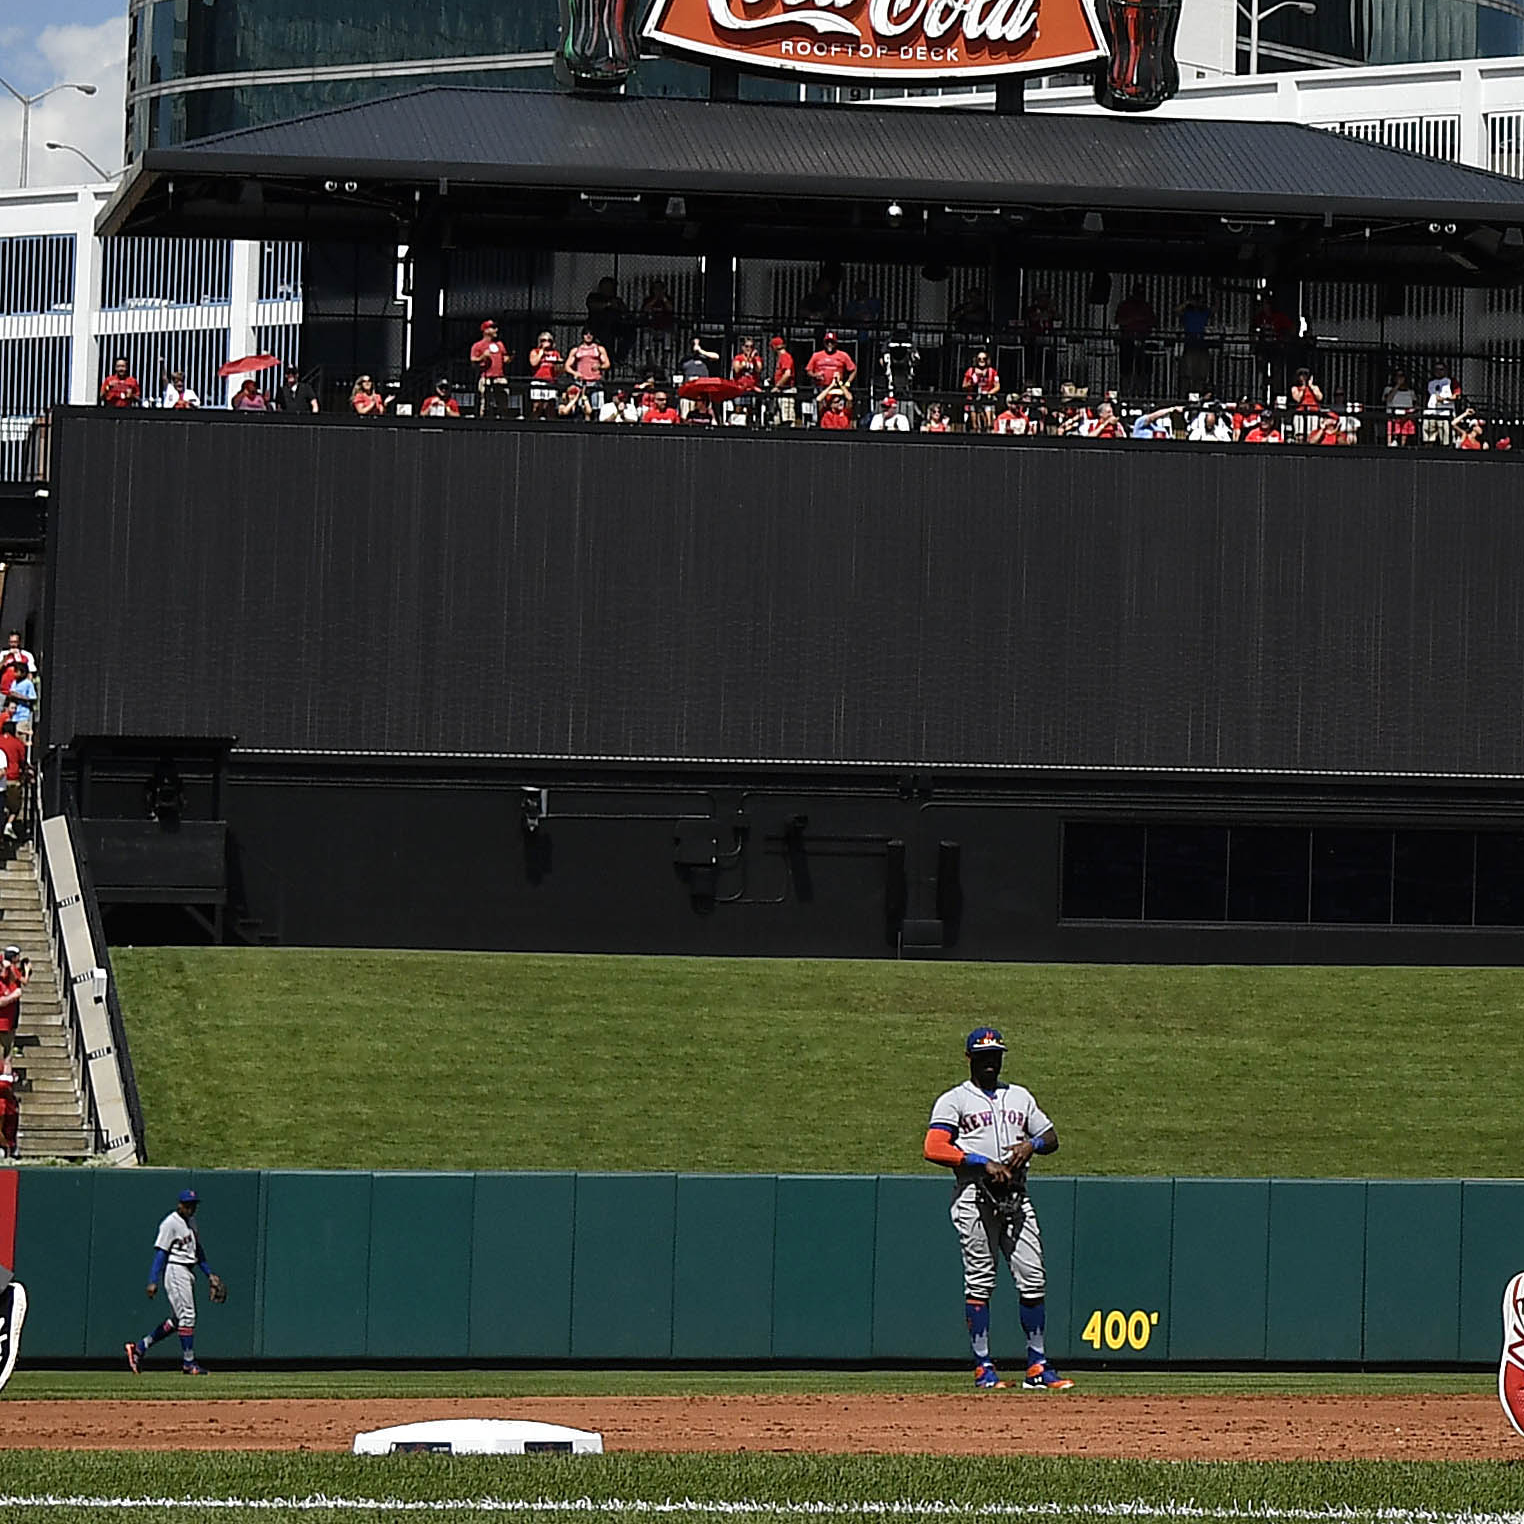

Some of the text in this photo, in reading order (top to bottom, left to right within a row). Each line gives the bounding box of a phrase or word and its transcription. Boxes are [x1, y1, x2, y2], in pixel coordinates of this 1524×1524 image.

[780, 39, 960, 63] ROOFTOP DECK
[1082, 1310, 1159, 1350] 400'
